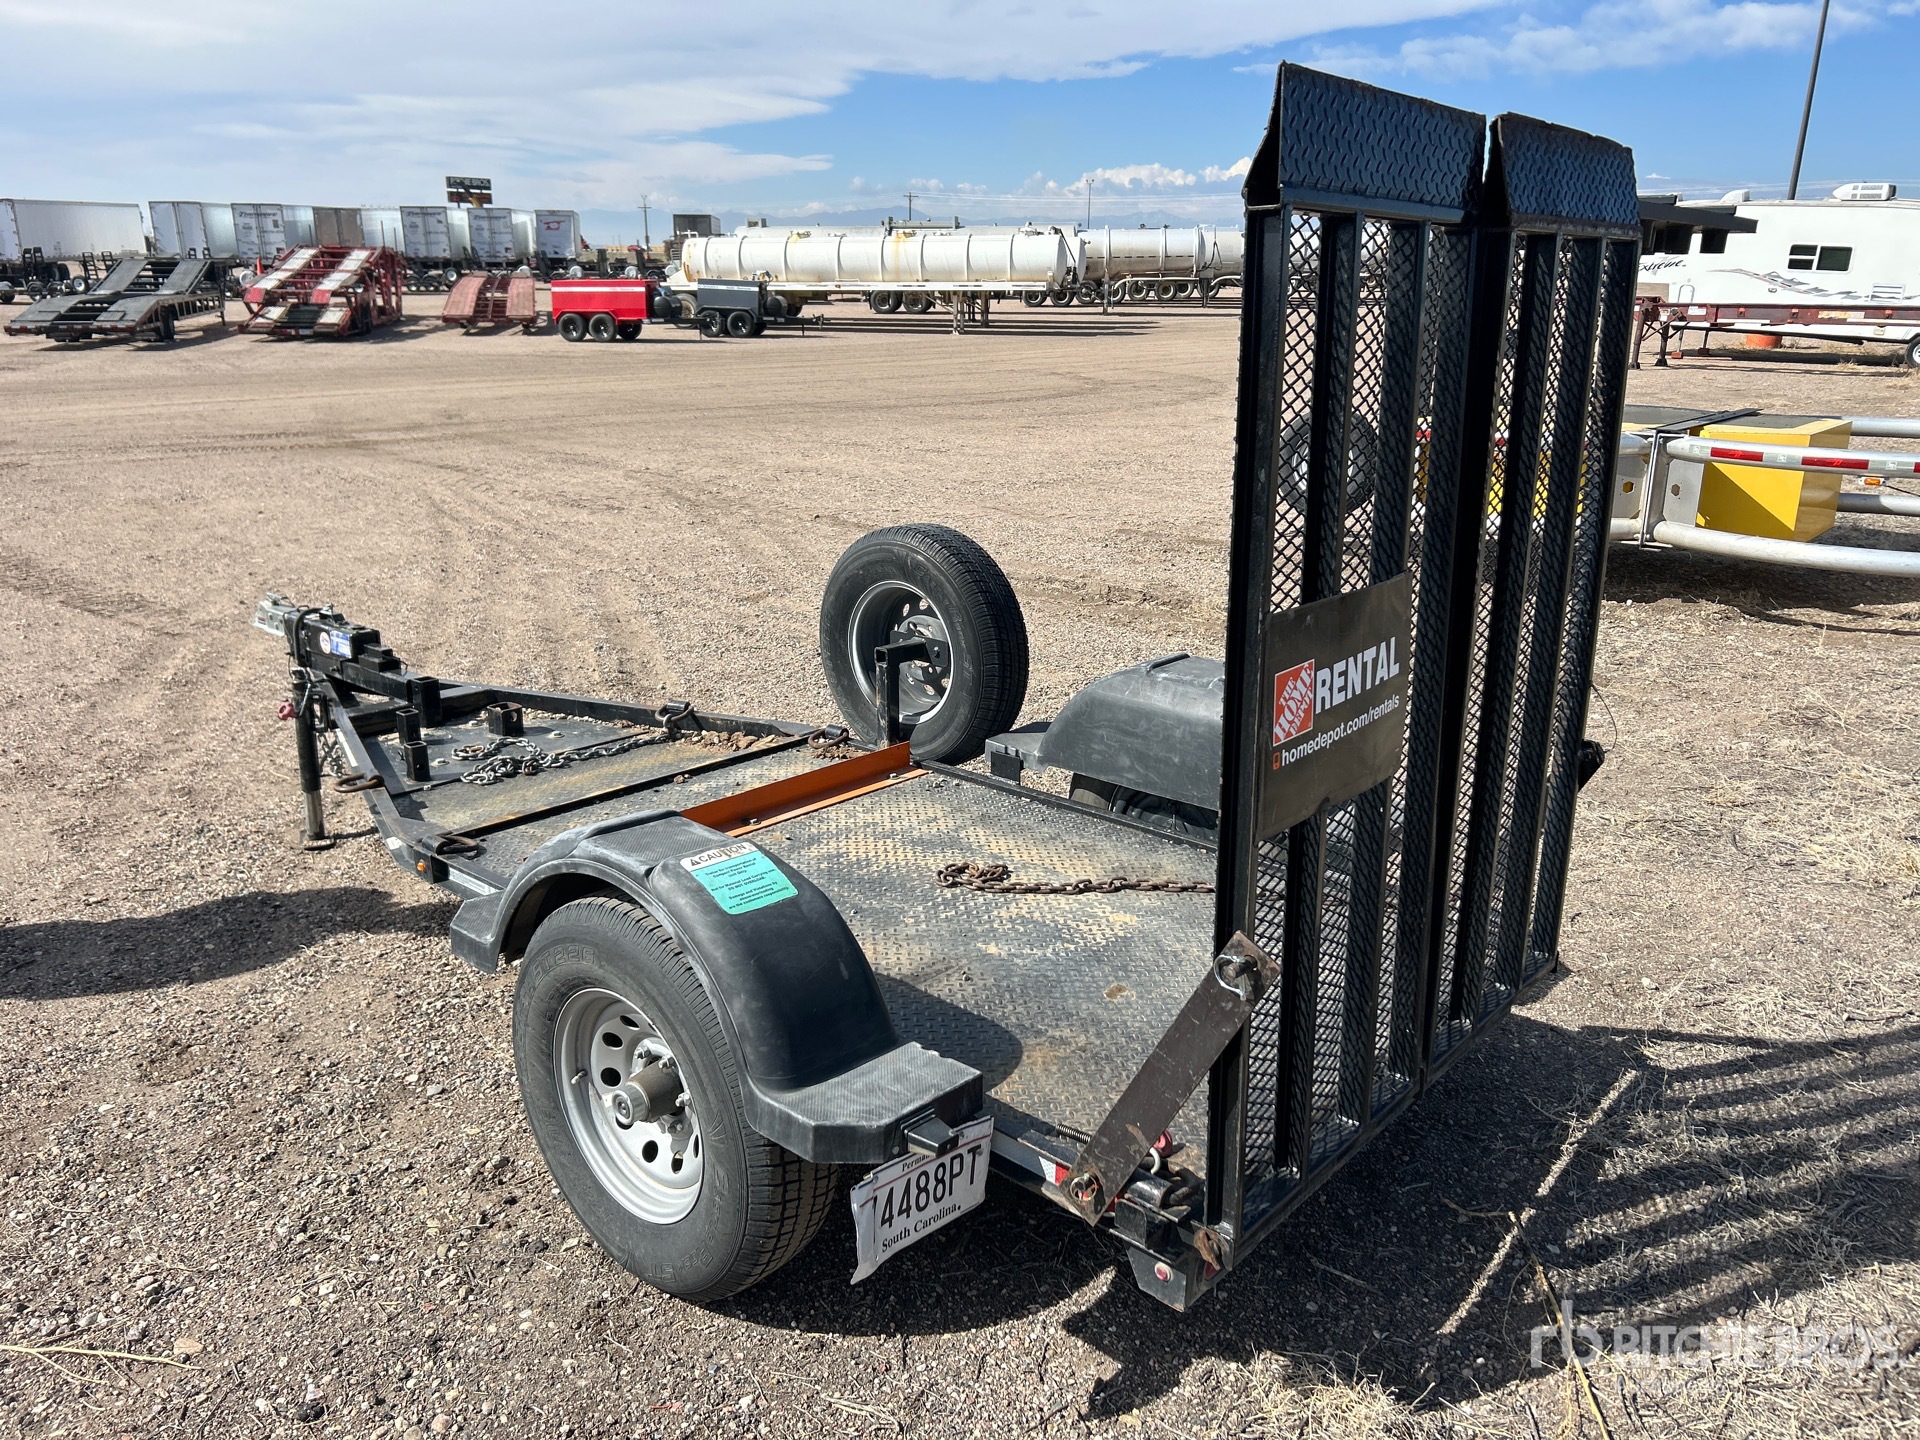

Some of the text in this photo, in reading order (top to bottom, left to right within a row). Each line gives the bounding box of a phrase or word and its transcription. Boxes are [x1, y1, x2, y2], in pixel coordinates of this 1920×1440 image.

[1273, 662, 1315, 742] HOME
[1278, 676, 1296, 707] THE
[1288, 686, 1314, 737] DEPOT
[1315, 636, 1400, 714] RENTAL
[1281, 694, 1400, 767] homedepot.com/rentals
[872, 1144, 982, 1244] 4488PT
[882, 1203, 958, 1253] South Carolina
